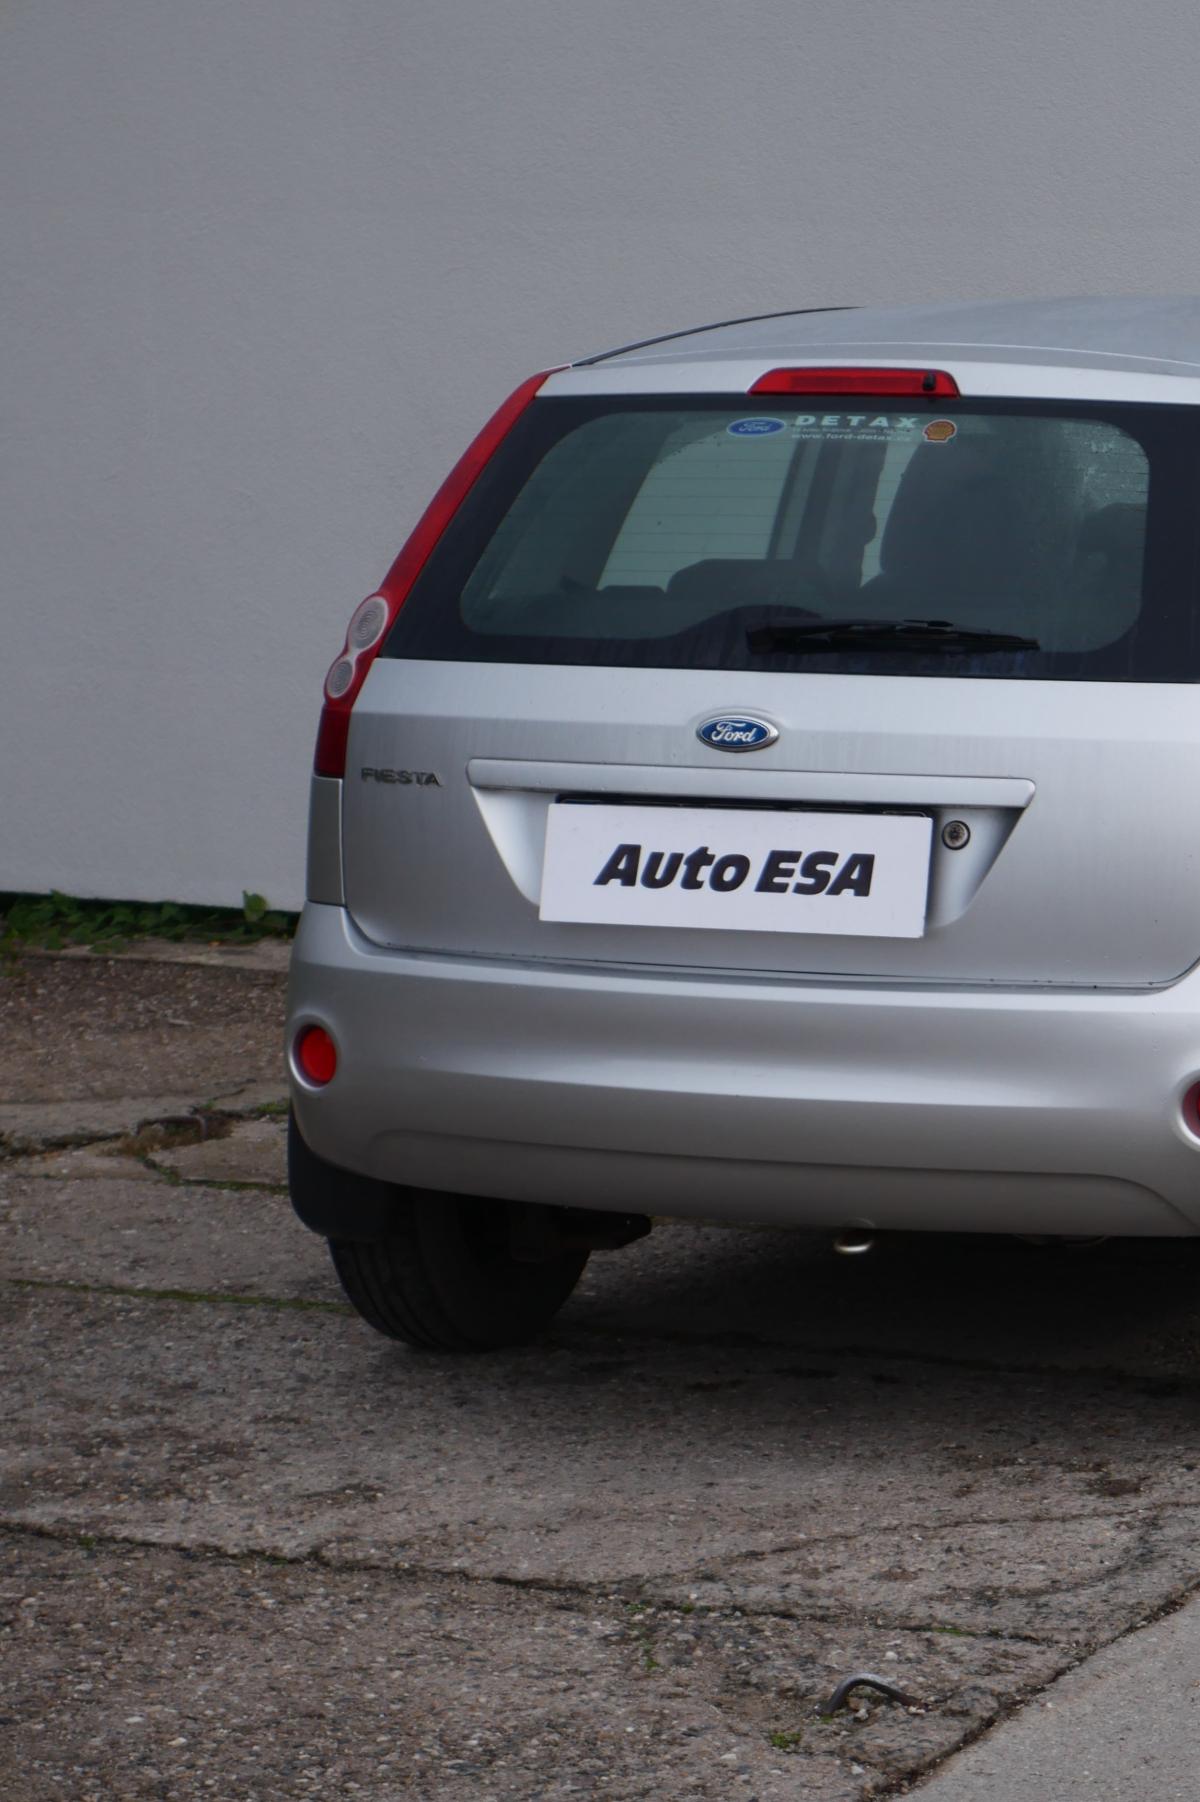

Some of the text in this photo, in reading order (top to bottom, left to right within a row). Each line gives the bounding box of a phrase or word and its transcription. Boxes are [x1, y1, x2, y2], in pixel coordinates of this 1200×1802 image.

[738, 421, 772, 432] Ford
[795, 415, 919, 428] DETAX
[711, 721, 756, 742] Ford
[361, 767, 442, 787] FIESTA
[593, 843, 875, 897] Auto ESA
